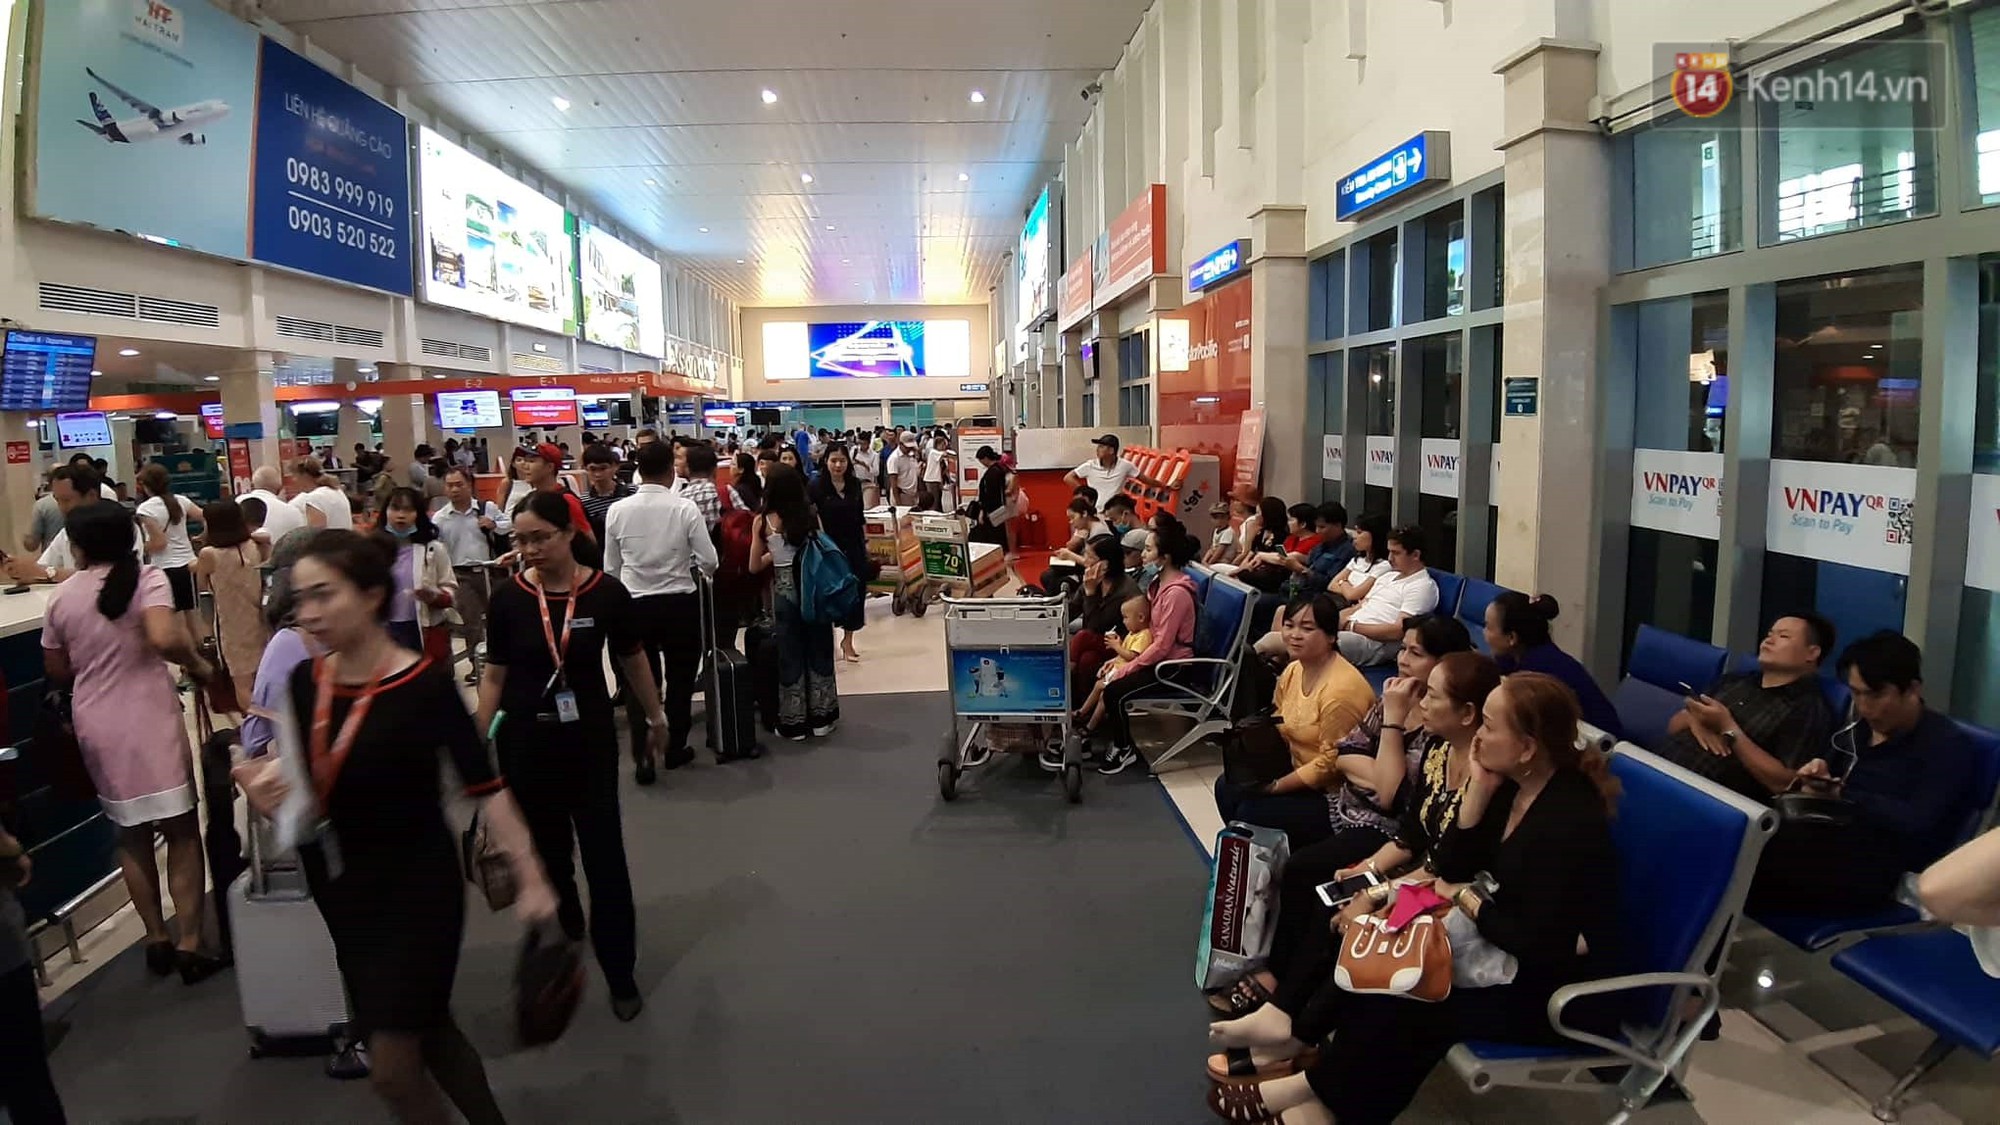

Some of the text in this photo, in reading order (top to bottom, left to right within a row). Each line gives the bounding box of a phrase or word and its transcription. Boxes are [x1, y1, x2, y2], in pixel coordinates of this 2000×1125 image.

[287, 157, 394, 219] 0983 999 919
[288, 206, 396, 260] 0903 520 522
[465, 378, 483, 389] E-2
[540, 376, 557, 387] E-1
[637, 374, 645, 385] E
[1427, 454, 1457, 471] VNPAY
[1643, 471, 1716, 496] VNPAY QR
[1784, 486, 1884, 518] VNPAY QR
[1791, 513, 1853, 536] Scan to Pay
[943, 553, 959, 568] 70
[1226, 841, 1241, 896] Naturals
[1220, 895, 1235, 948] CANADIAN
